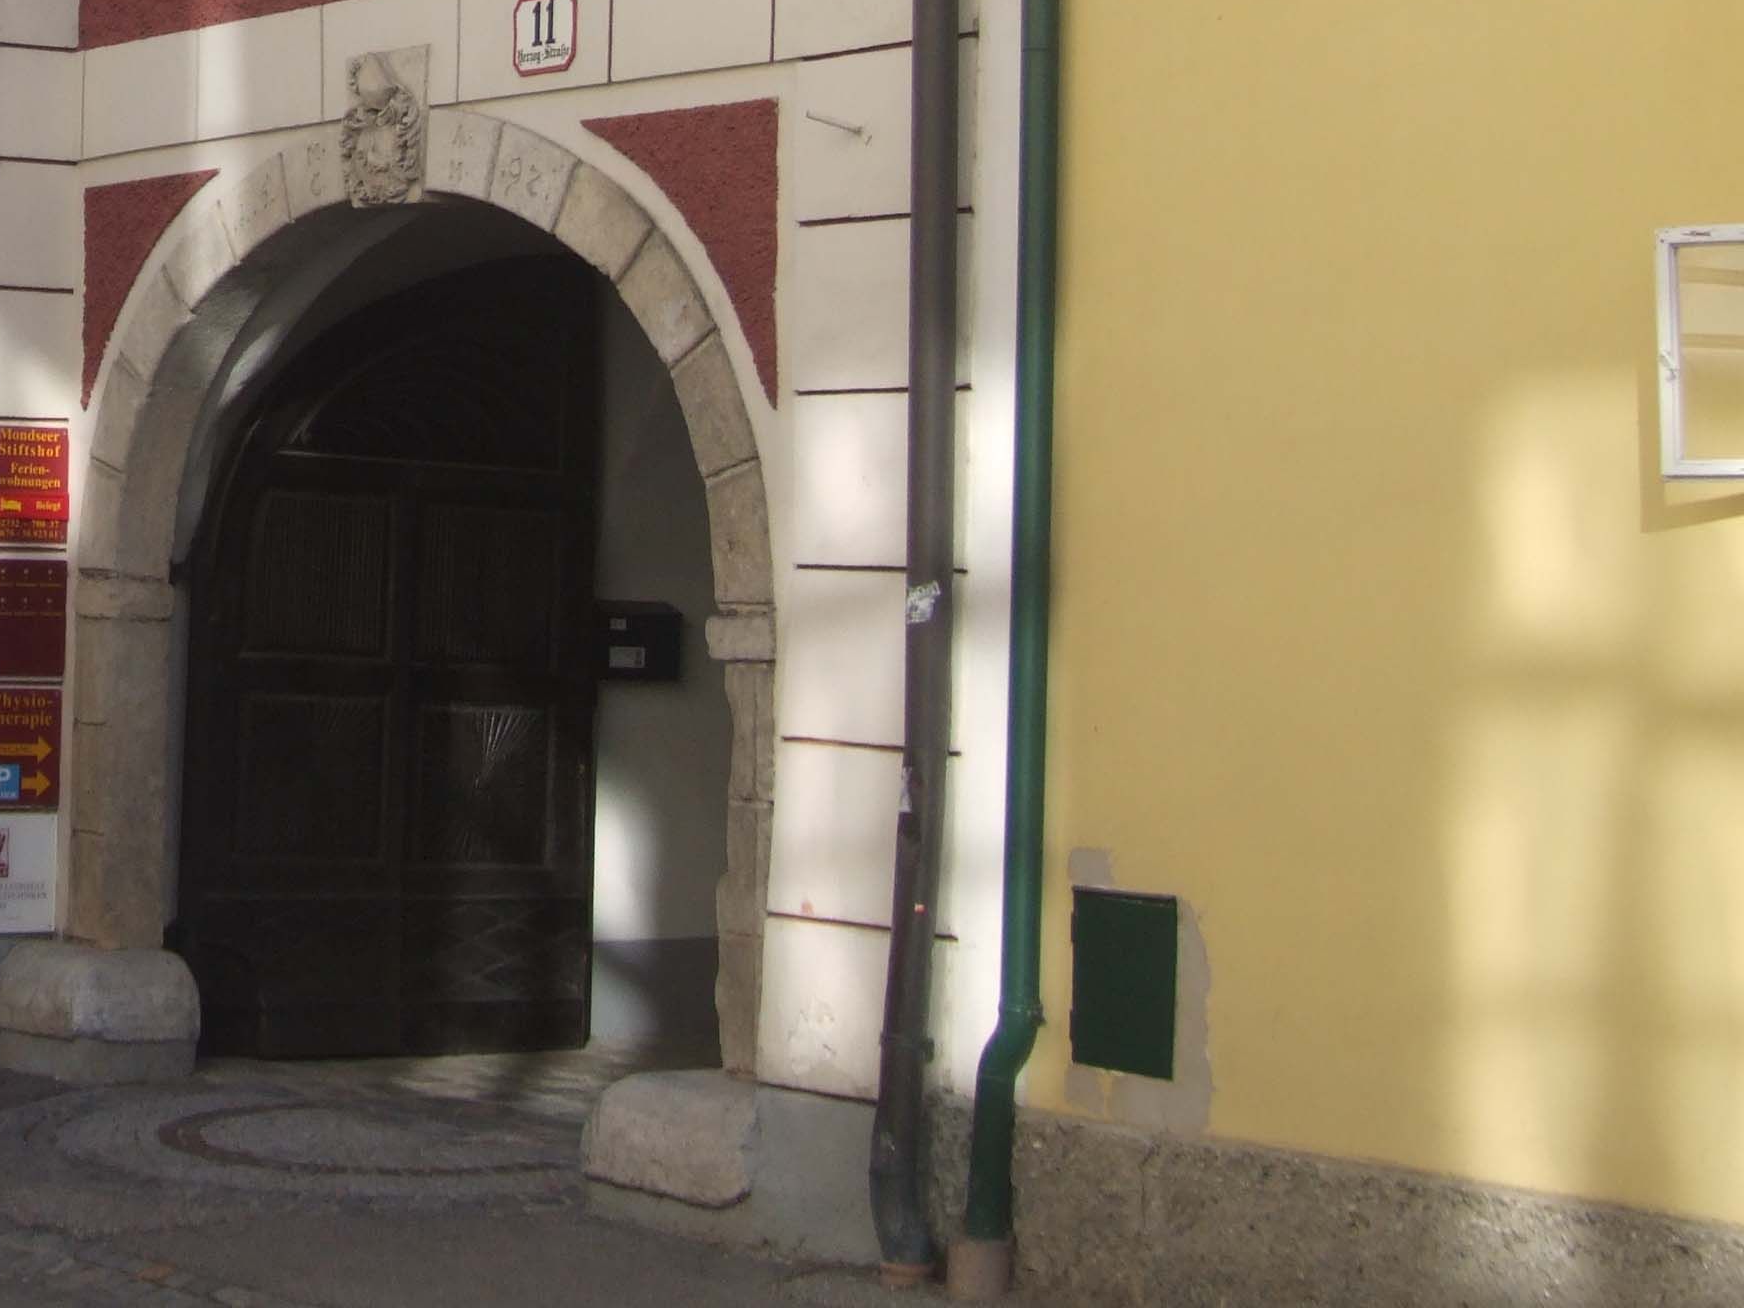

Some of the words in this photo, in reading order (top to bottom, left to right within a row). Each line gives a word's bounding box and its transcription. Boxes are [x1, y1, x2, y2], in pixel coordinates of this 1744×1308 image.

[532, 0, 556, 47] 11
[0, 427, 61, 442] Mondseer
[10, 462, 51, 476] Ferien-
[0, 476, 61, 490] wohnungen
